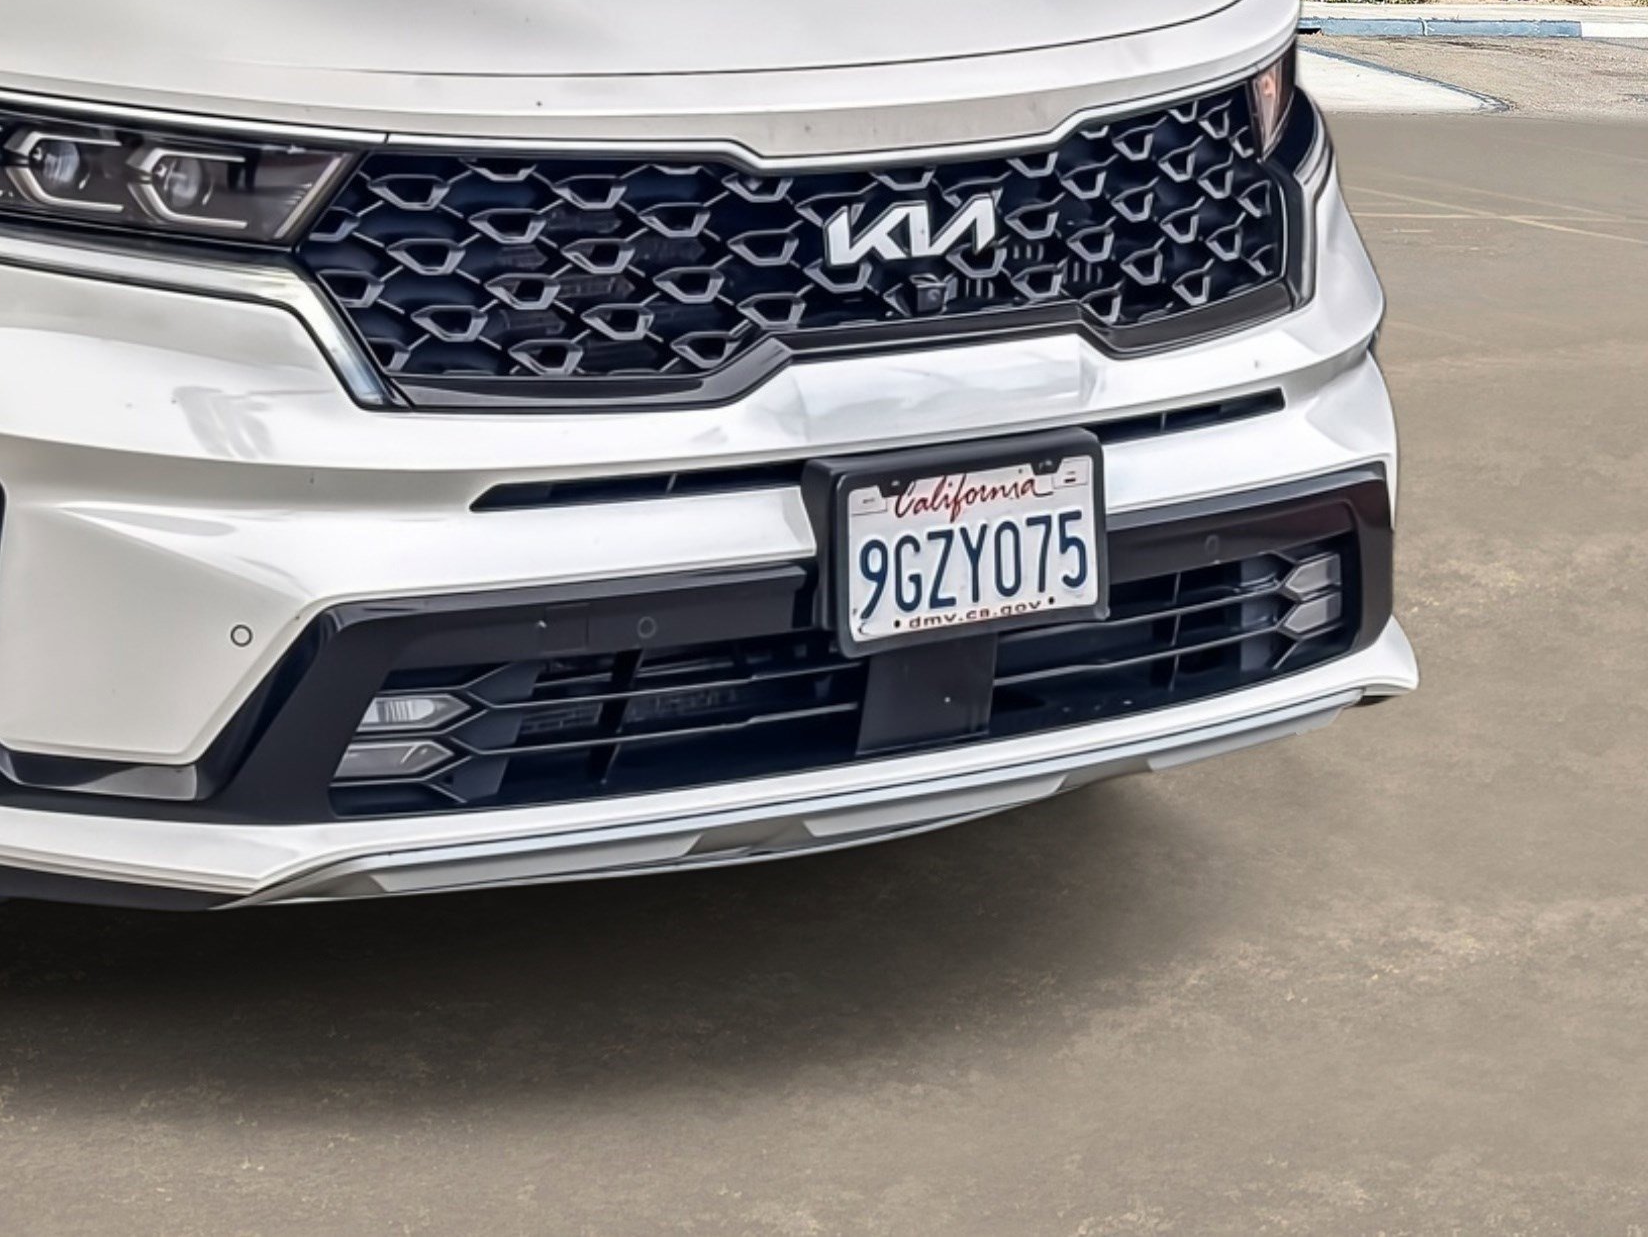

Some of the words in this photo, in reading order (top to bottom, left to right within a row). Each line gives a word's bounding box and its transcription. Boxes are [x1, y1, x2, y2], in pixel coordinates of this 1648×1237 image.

[825, 194, 996, 266] KIA
[893, 473, 1054, 523] California
[859, 509, 1089, 620] 9GZY075
[908, 600, 1042, 630] dmv.ca.gov
